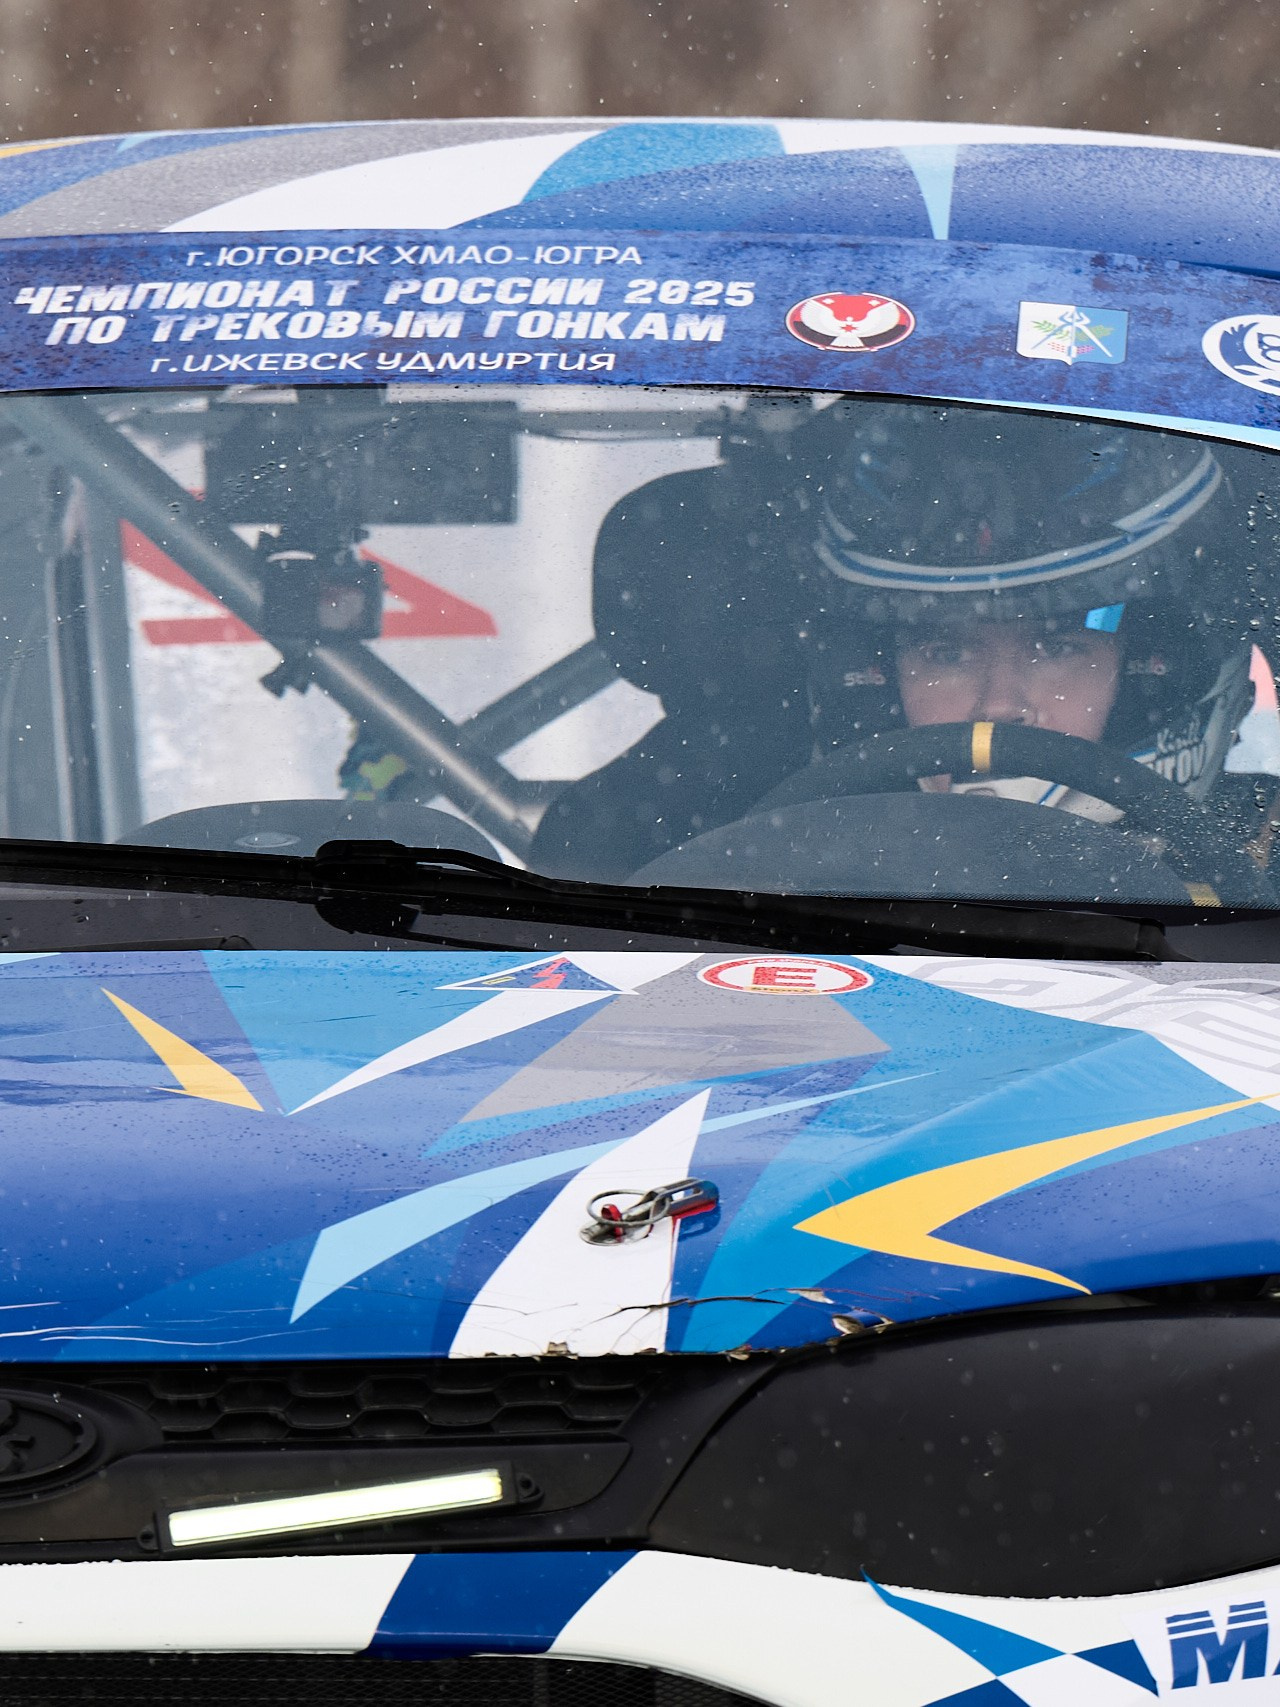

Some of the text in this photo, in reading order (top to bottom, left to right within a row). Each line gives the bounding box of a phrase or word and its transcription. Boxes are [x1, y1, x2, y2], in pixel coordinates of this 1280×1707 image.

[187, 245, 643, 267] г.ЮГОРСК ХМАО-ЮГРА
[15, 277, 756, 315] ЧЕМПИОНАТ РОССИИ 2025
[44, 311, 726, 346] ПО ТРЕКОВЫМ ГОНКАМ
[150, 351, 616, 374] г.ИЖЕВСК УДМУРТИЯ
